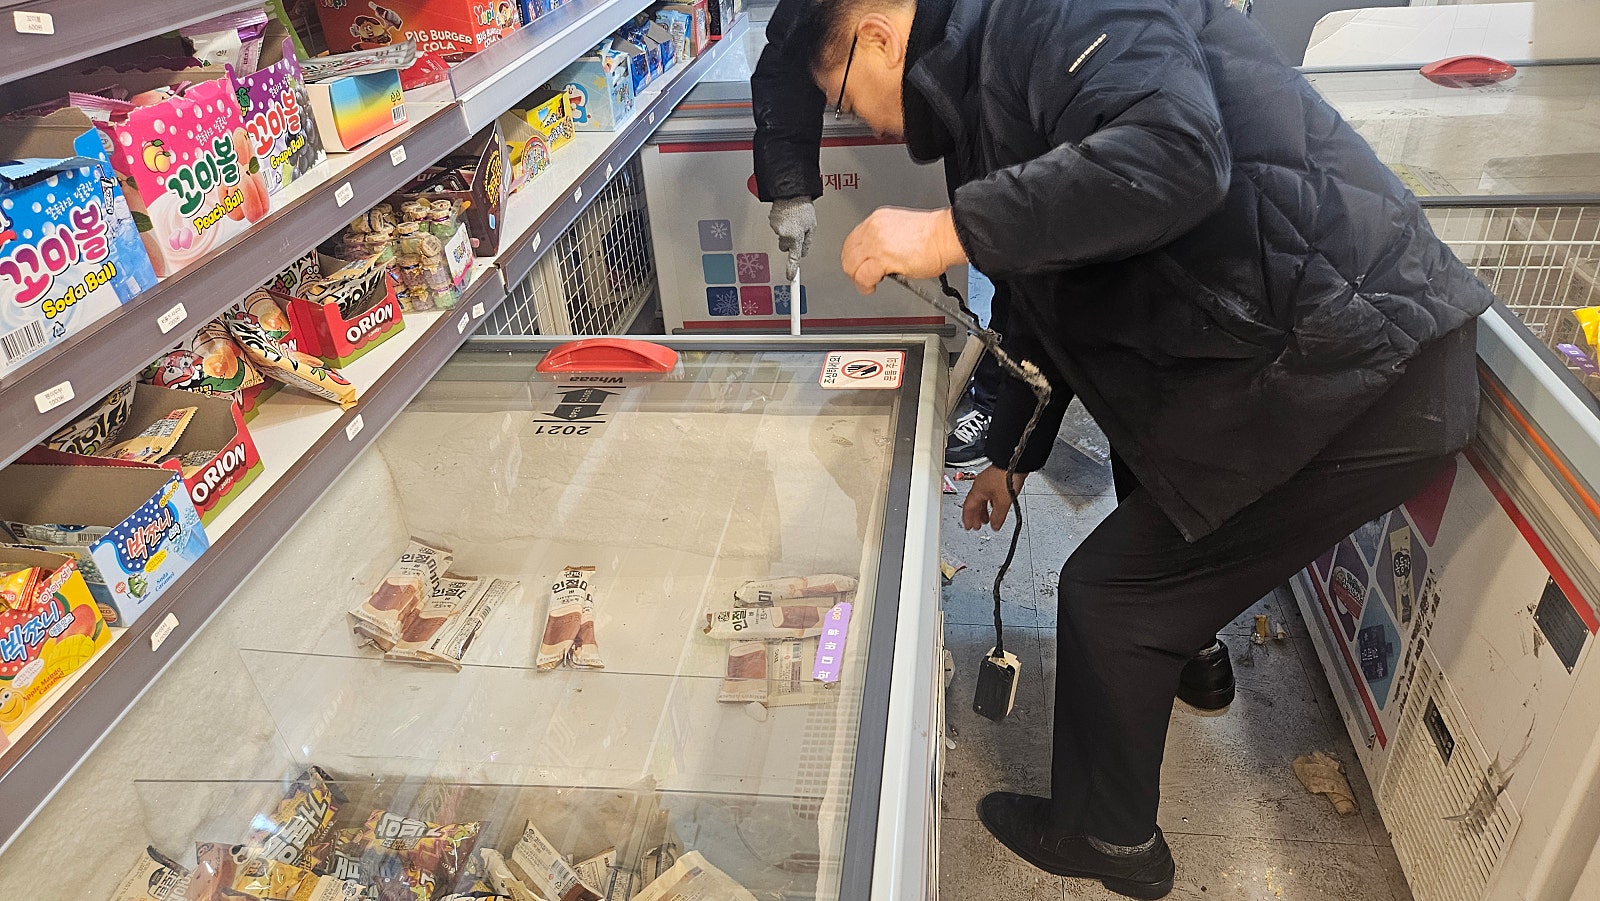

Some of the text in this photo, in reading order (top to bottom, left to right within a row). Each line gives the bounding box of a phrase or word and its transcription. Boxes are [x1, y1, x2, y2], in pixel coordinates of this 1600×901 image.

[474, 2, 495, 25] Yupi
[423, 41, 456, 52] COLA
[429, 29, 473, 45] BURGER
[476, 29, 488, 44] BIG
[247, 88, 302, 158] 꼬미볼
[270, 134, 305, 170] Grape Ball
[169, 136, 240, 214] 꼬미볼
[193, 189, 244, 234] Peach Ball
[0, 203, 108, 305] 꼬미볼
[41, 261, 117, 319] Soda Ball
[346, 303, 393, 343] ORION
[885, 357, 899, 369] 주의
[535, 424, 593, 436] 2021
[191, 443, 247, 503] ORION
[832, 606, 843, 621] 800
[40, 667, 62, 688] Mango
